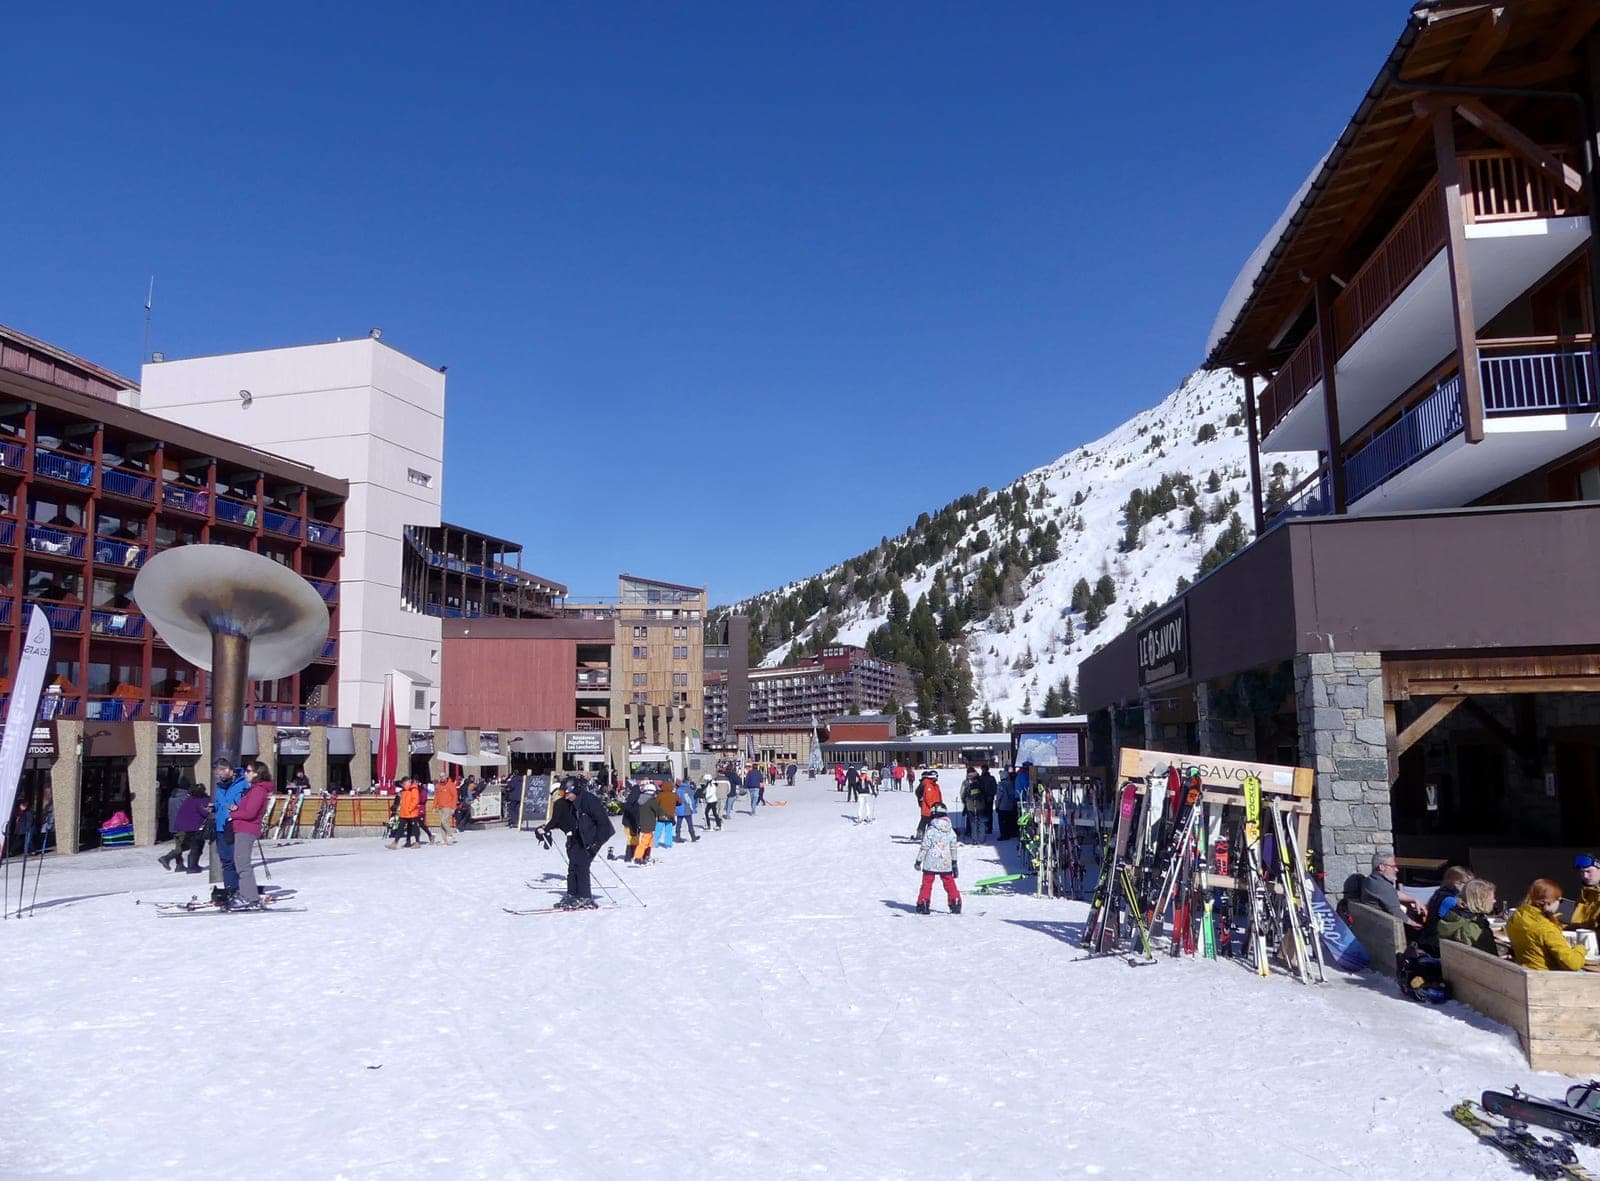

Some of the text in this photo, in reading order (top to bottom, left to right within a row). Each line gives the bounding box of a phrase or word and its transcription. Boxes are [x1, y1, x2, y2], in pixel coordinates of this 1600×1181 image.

[1140, 617, 1182, 666] LE SAVOY
[29, 746, 54, 754] TDOOR
[1199, 763, 1262, 781] SAVOY
